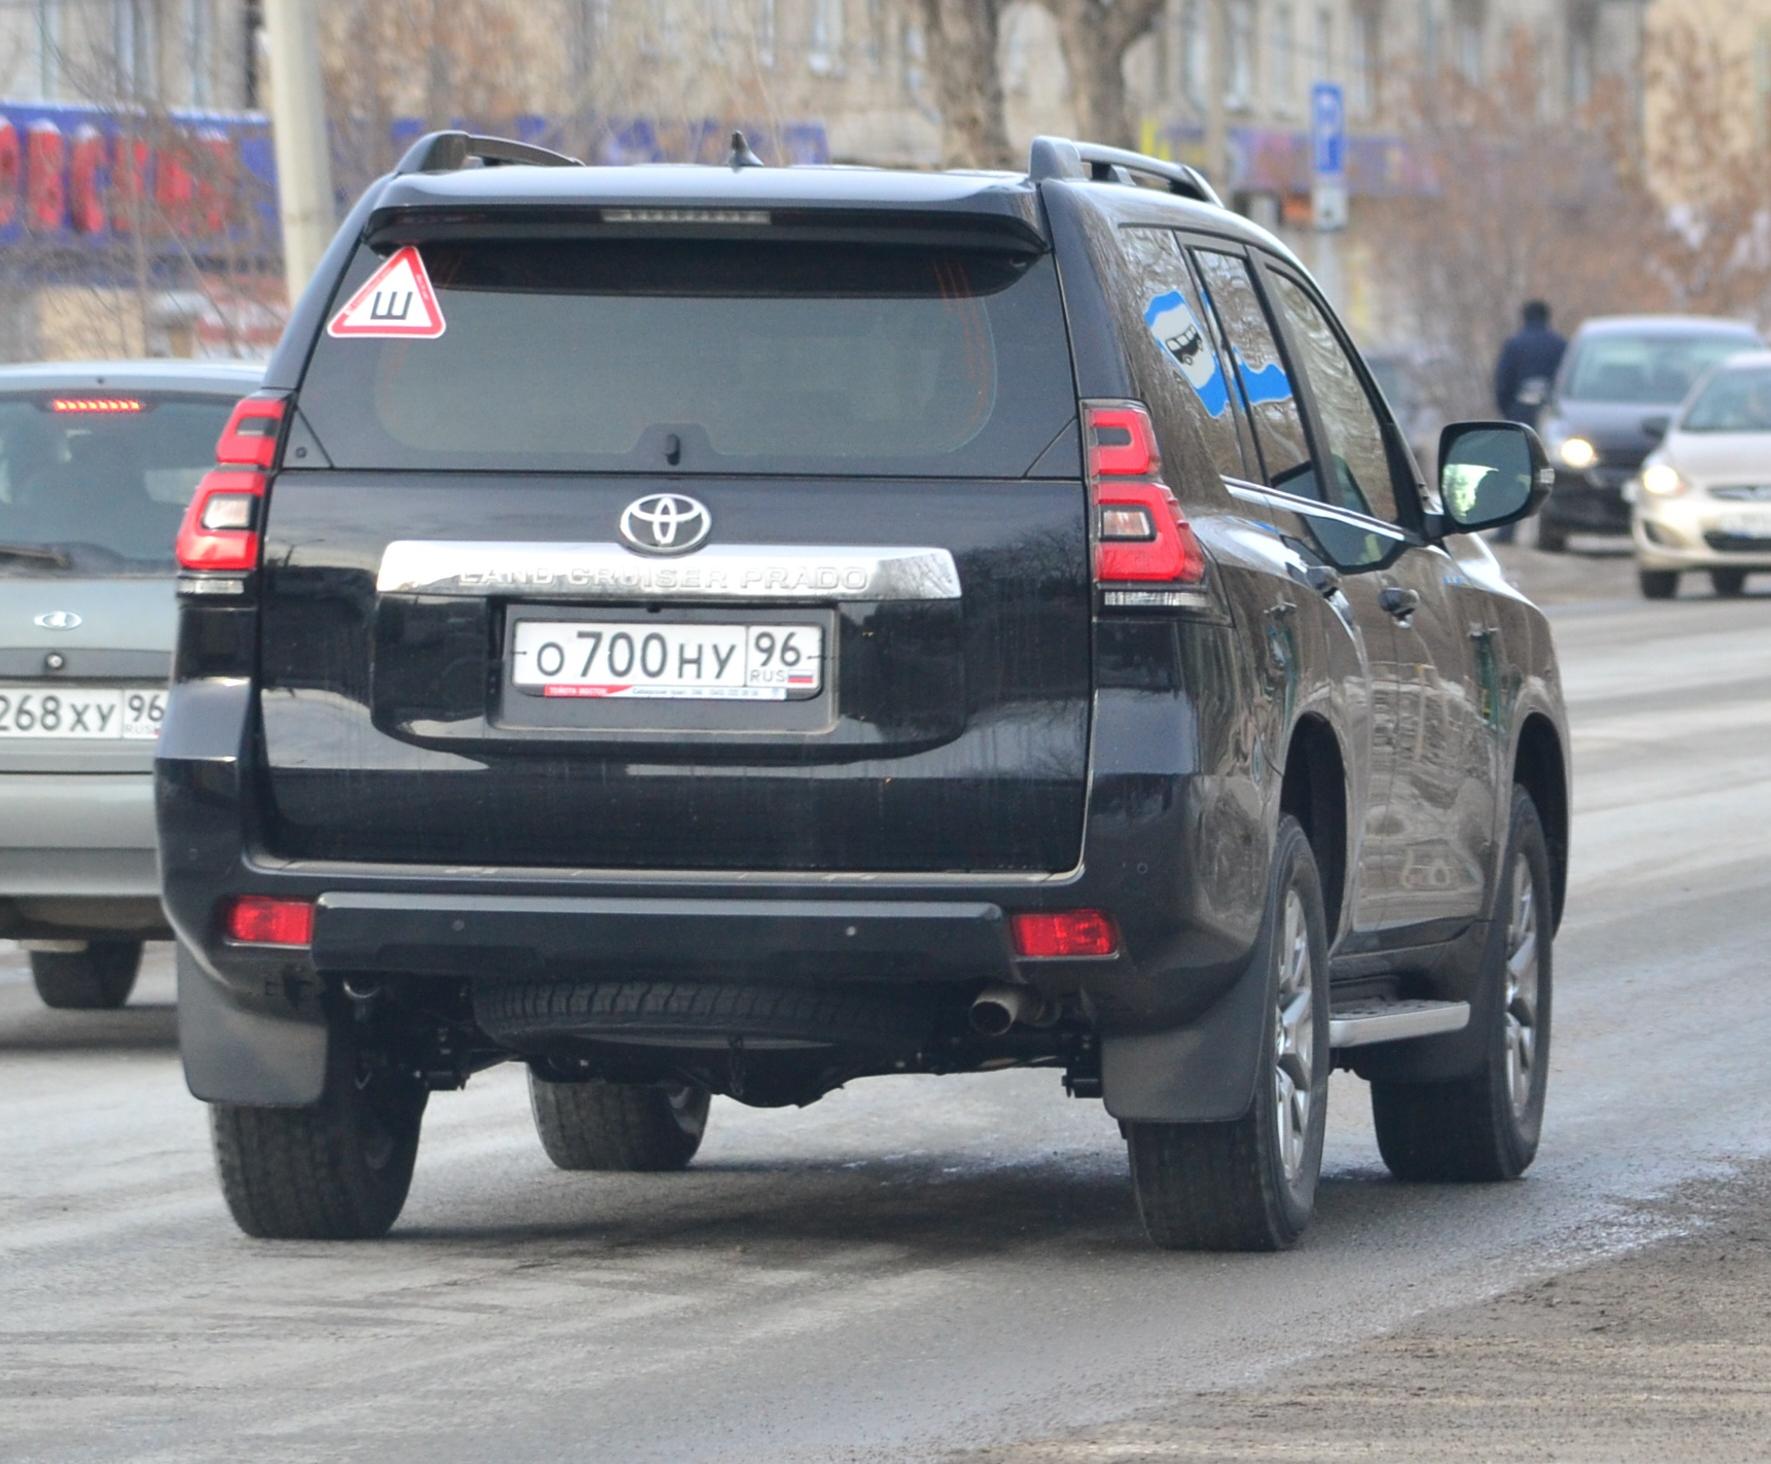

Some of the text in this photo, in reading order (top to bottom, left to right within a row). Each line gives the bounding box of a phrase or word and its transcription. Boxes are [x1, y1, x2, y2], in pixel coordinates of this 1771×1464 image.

[370, 291, 413, 320] Ш
[459, 567, 868, 590] LAND CRUISER PRADO
[754, 632, 801, 667] 96
[750, 669, 785, 683] RUS
[129, 694, 165, 722] 96
